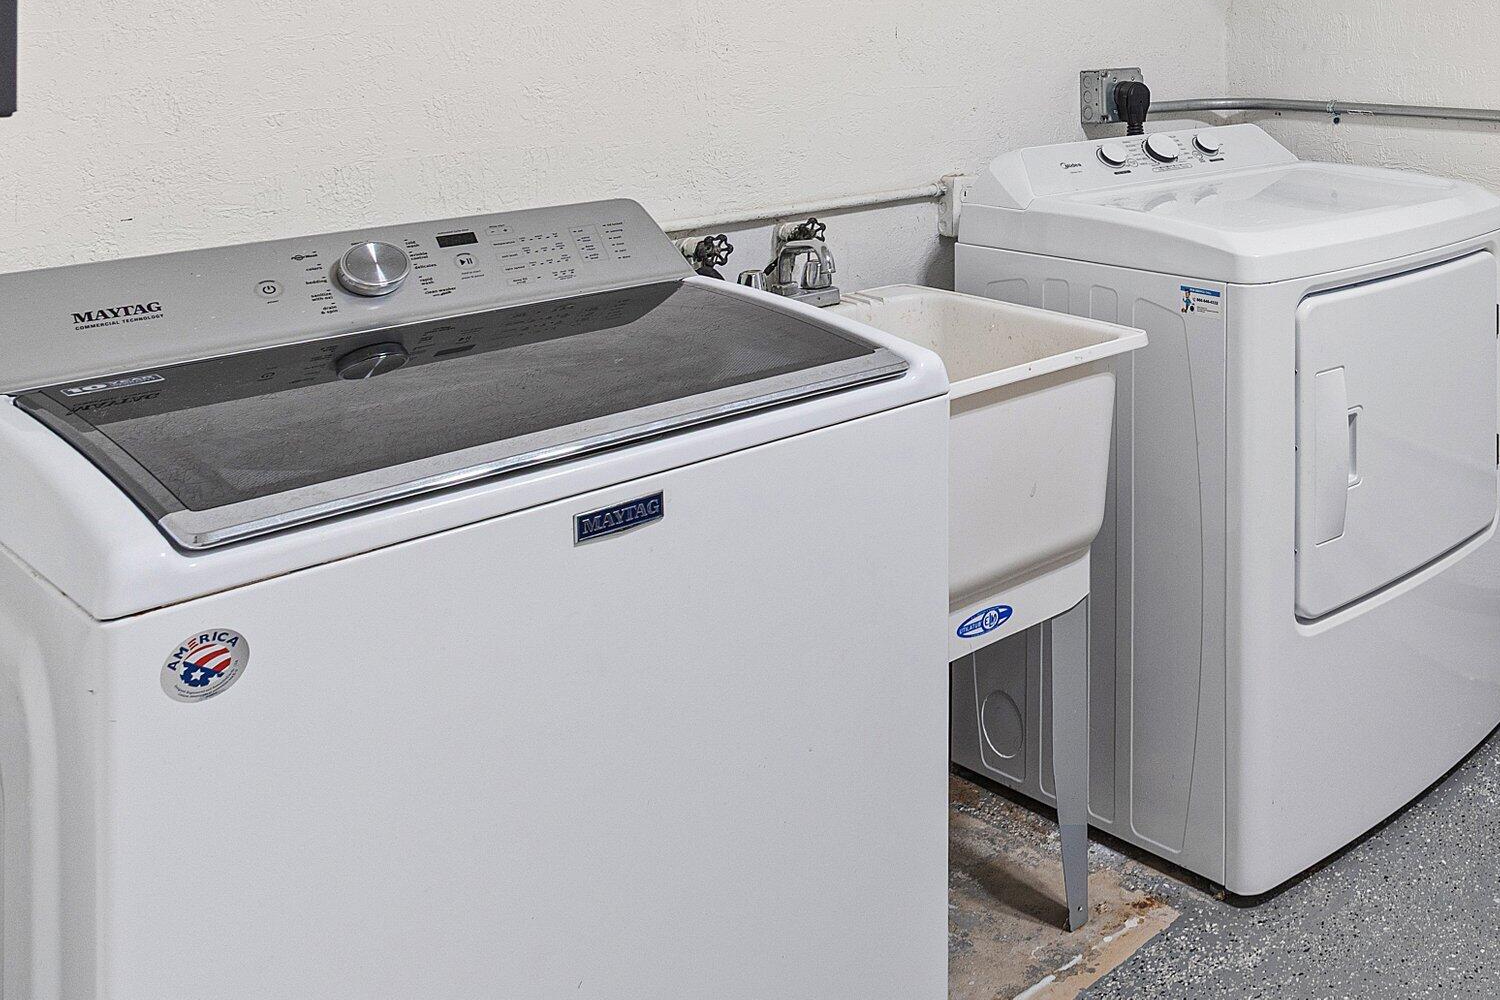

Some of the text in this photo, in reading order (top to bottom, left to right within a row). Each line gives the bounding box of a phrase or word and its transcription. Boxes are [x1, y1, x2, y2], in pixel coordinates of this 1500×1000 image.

[71, 301, 162, 324] MAYTAG
[75, 313, 164, 331] COMMERCIAL TECHNOLOGY
[581, 498, 661, 535] MAYTAG
[166, 631, 240, 671] AMERICA
